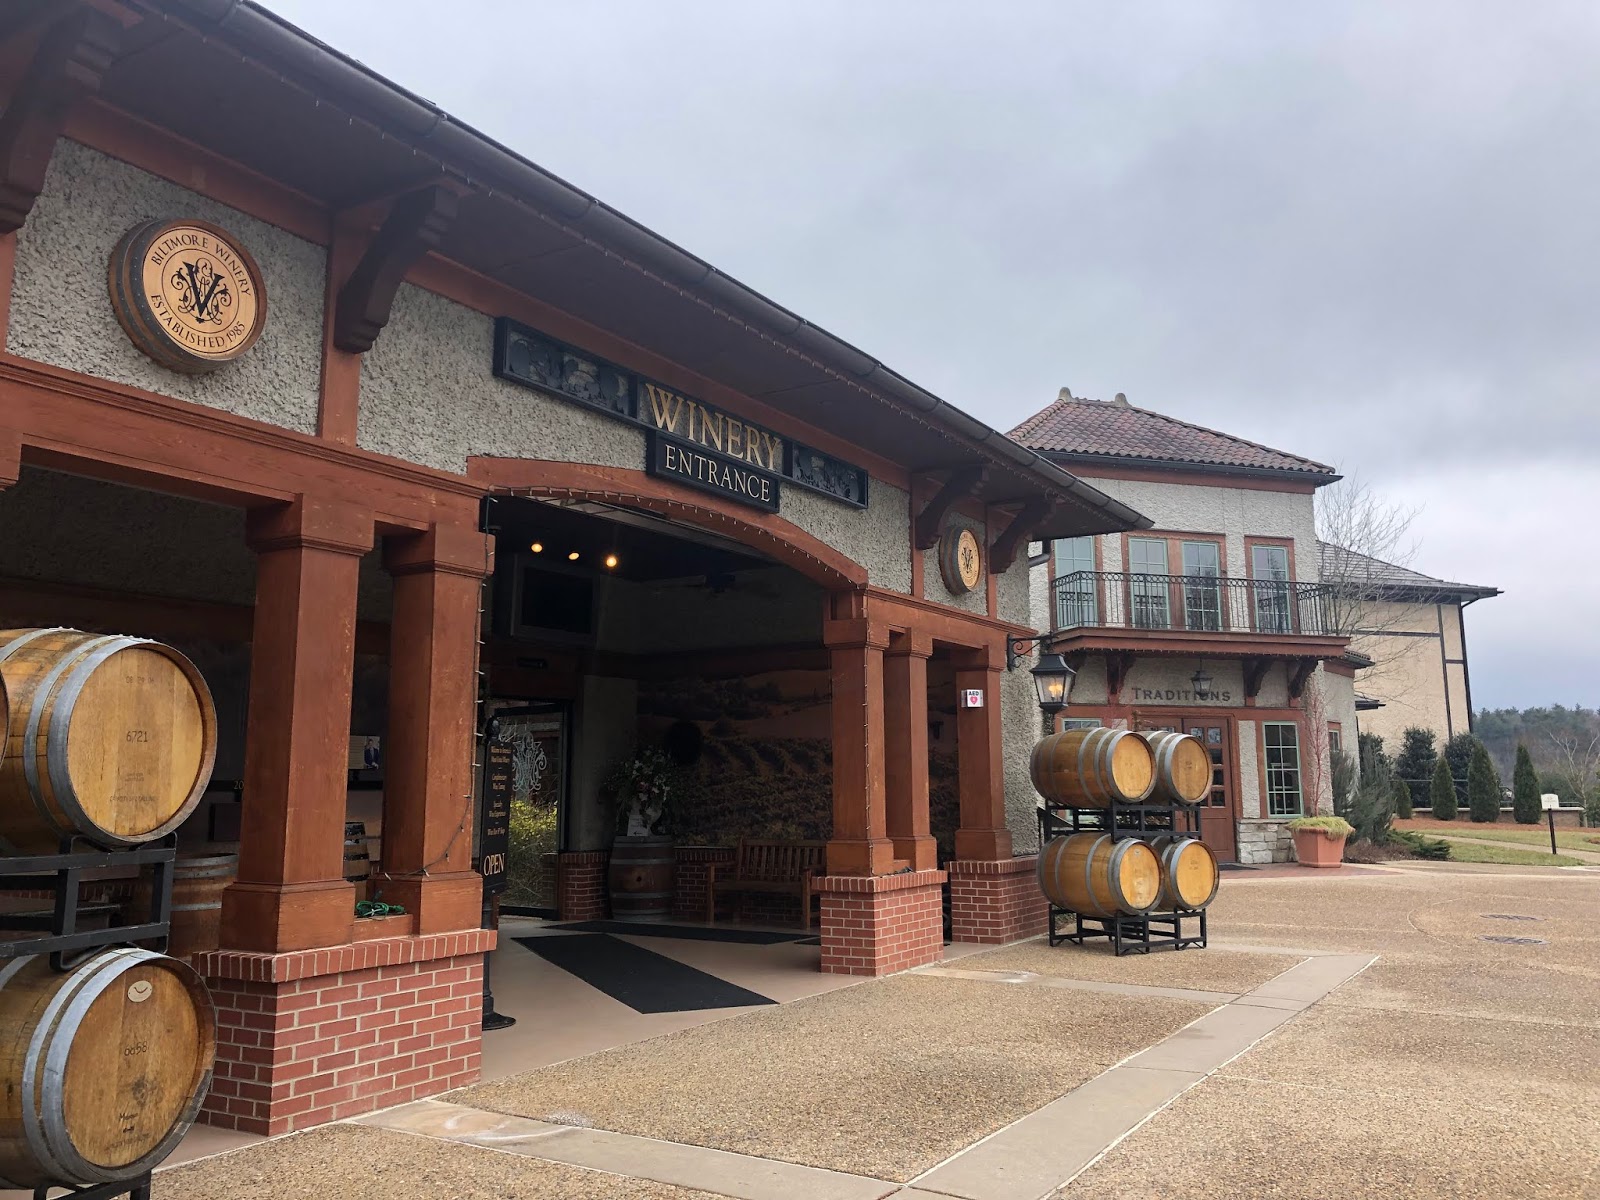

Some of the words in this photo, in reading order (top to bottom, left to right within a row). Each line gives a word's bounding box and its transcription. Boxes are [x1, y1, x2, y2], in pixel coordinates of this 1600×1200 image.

[151, 234, 209, 266] BILTMORE
[215, 244, 251, 296] WINERY
[151, 294, 225, 348] ESTABLISHED
[226, 321, 246, 344] 1985
[645, 383, 782, 471] WINERY
[665, 444, 771, 503] ENTRANCE
[126, 730, 149, 743] 6721
[483, 852, 506, 876] OPEN
